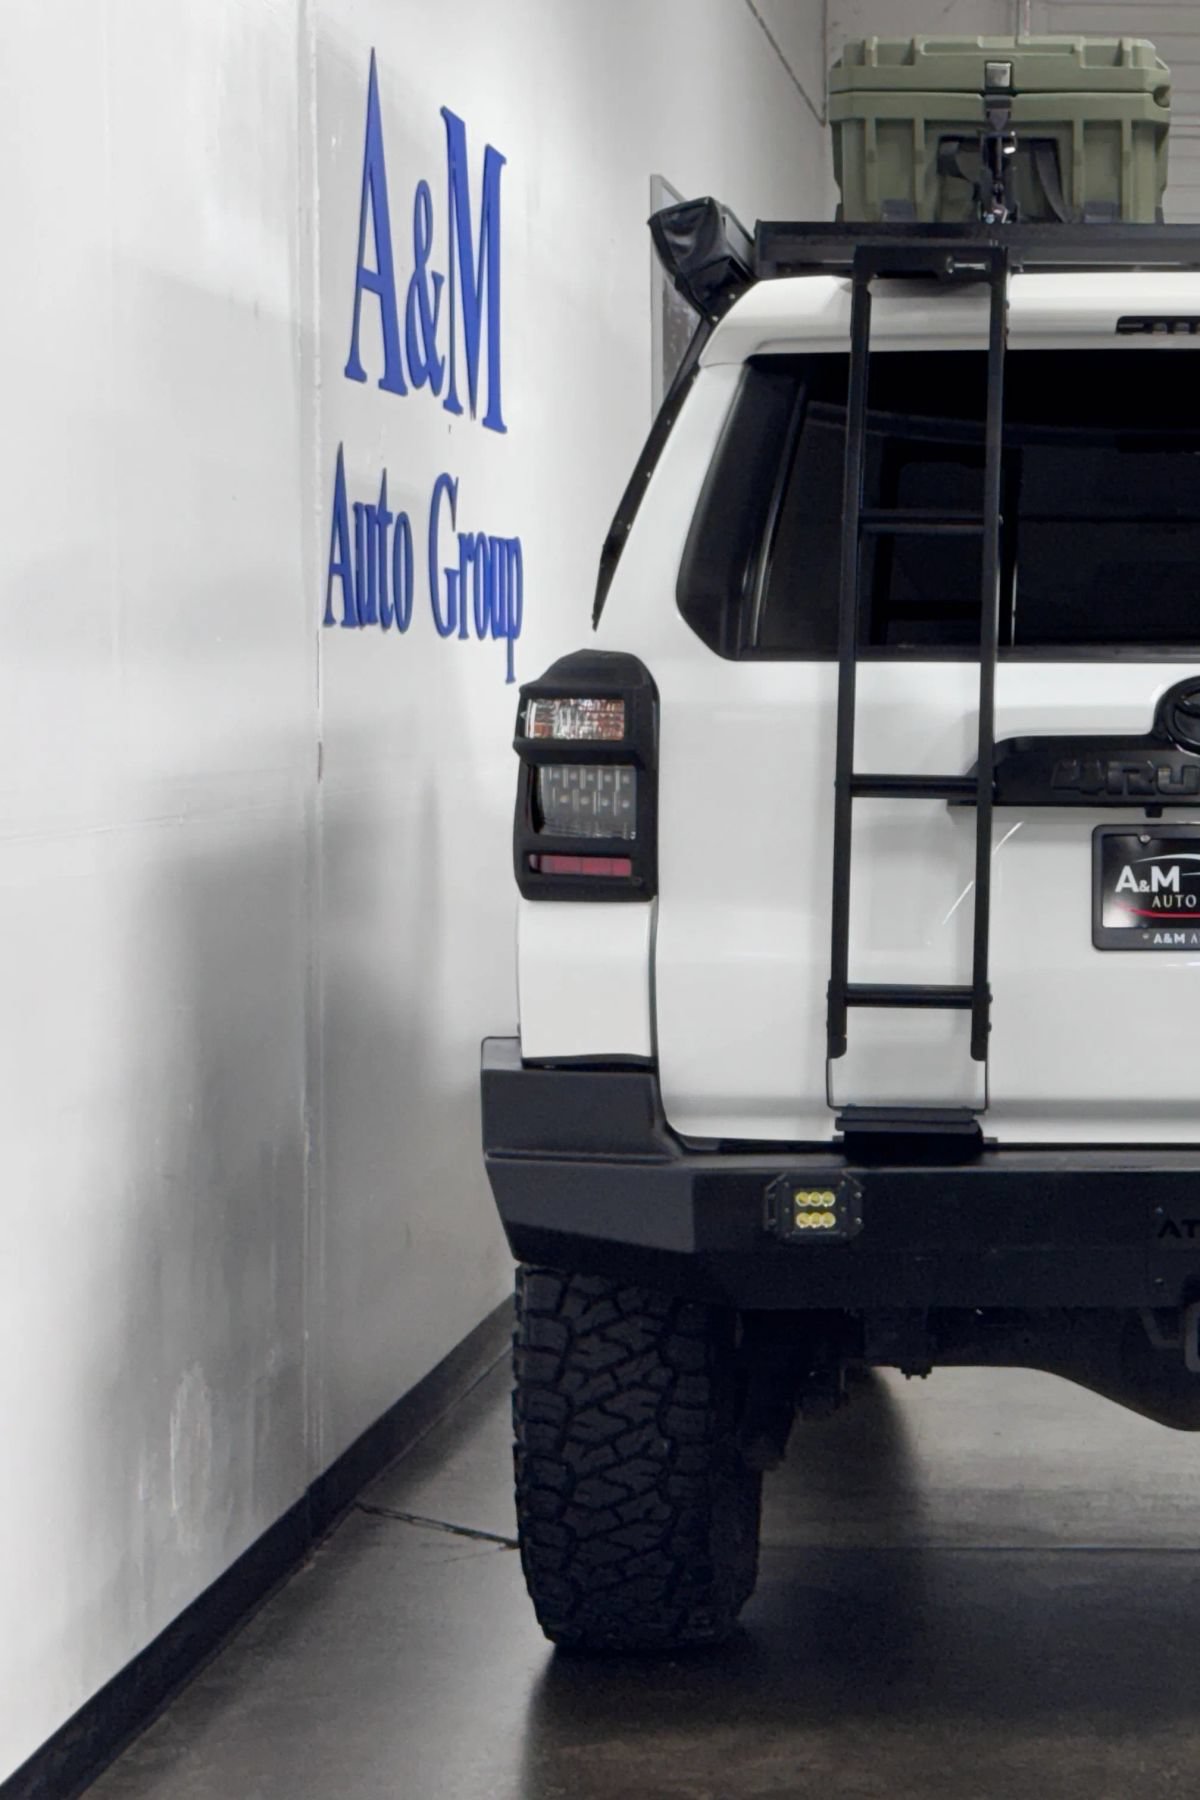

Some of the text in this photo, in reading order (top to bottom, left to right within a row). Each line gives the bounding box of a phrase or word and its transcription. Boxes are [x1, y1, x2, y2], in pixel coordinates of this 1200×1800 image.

[345, 47, 507, 434] A&M
[323, 441, 523, 684] Auto Group
[1115, 865, 1180, 892] A&M
[1152, 895, 1197, 908] AUTO
[1153, 932, 1186, 944] A&M
